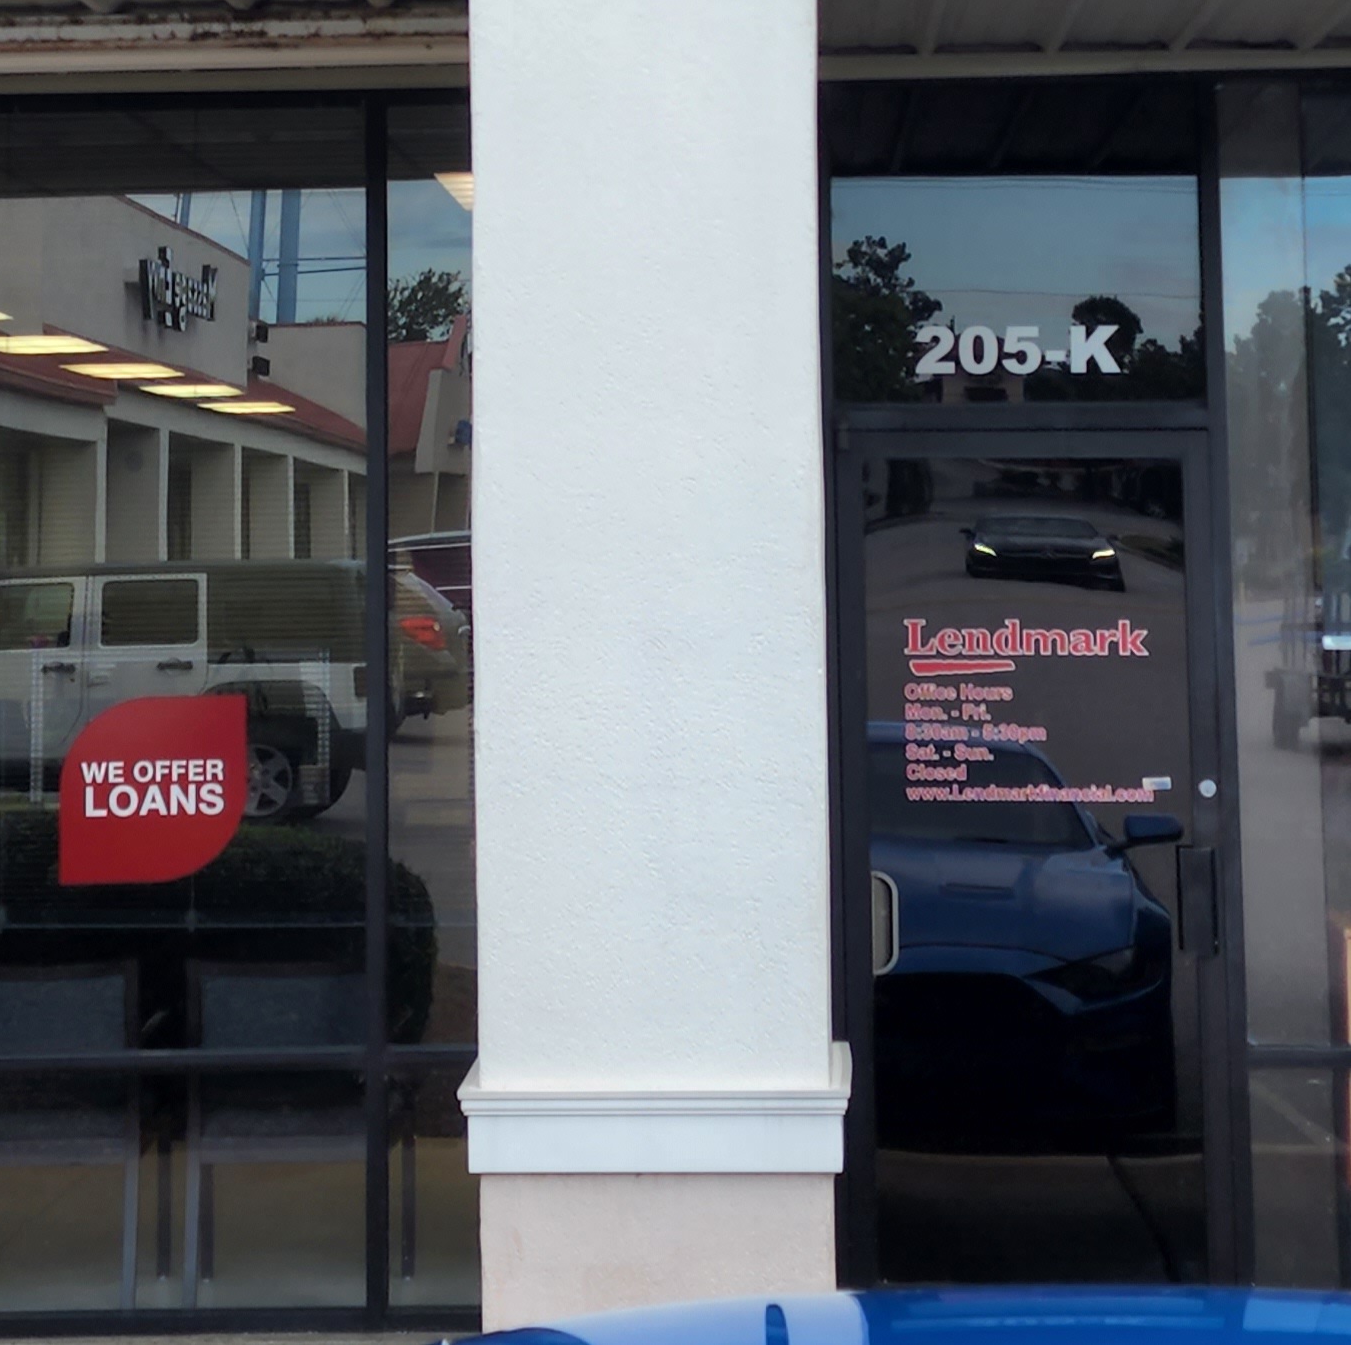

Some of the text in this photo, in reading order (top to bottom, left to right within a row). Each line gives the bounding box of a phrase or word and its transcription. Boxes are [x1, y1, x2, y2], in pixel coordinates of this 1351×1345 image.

[914, 324, 1122, 375] 205-K
[903, 618, 1150, 656] Lendmark
[904, 683, 1013, 701] Office Hours
[905, 703, 948, 720] Mon.
[962, 703, 991, 720] Fri.
[905, 743, 940, 761] Sat.
[954, 742, 994, 761] Sun.
[81, 759, 224, 784] WE OFFER
[905, 764, 968, 782] Closed
[85, 783, 225, 818] LOANS
